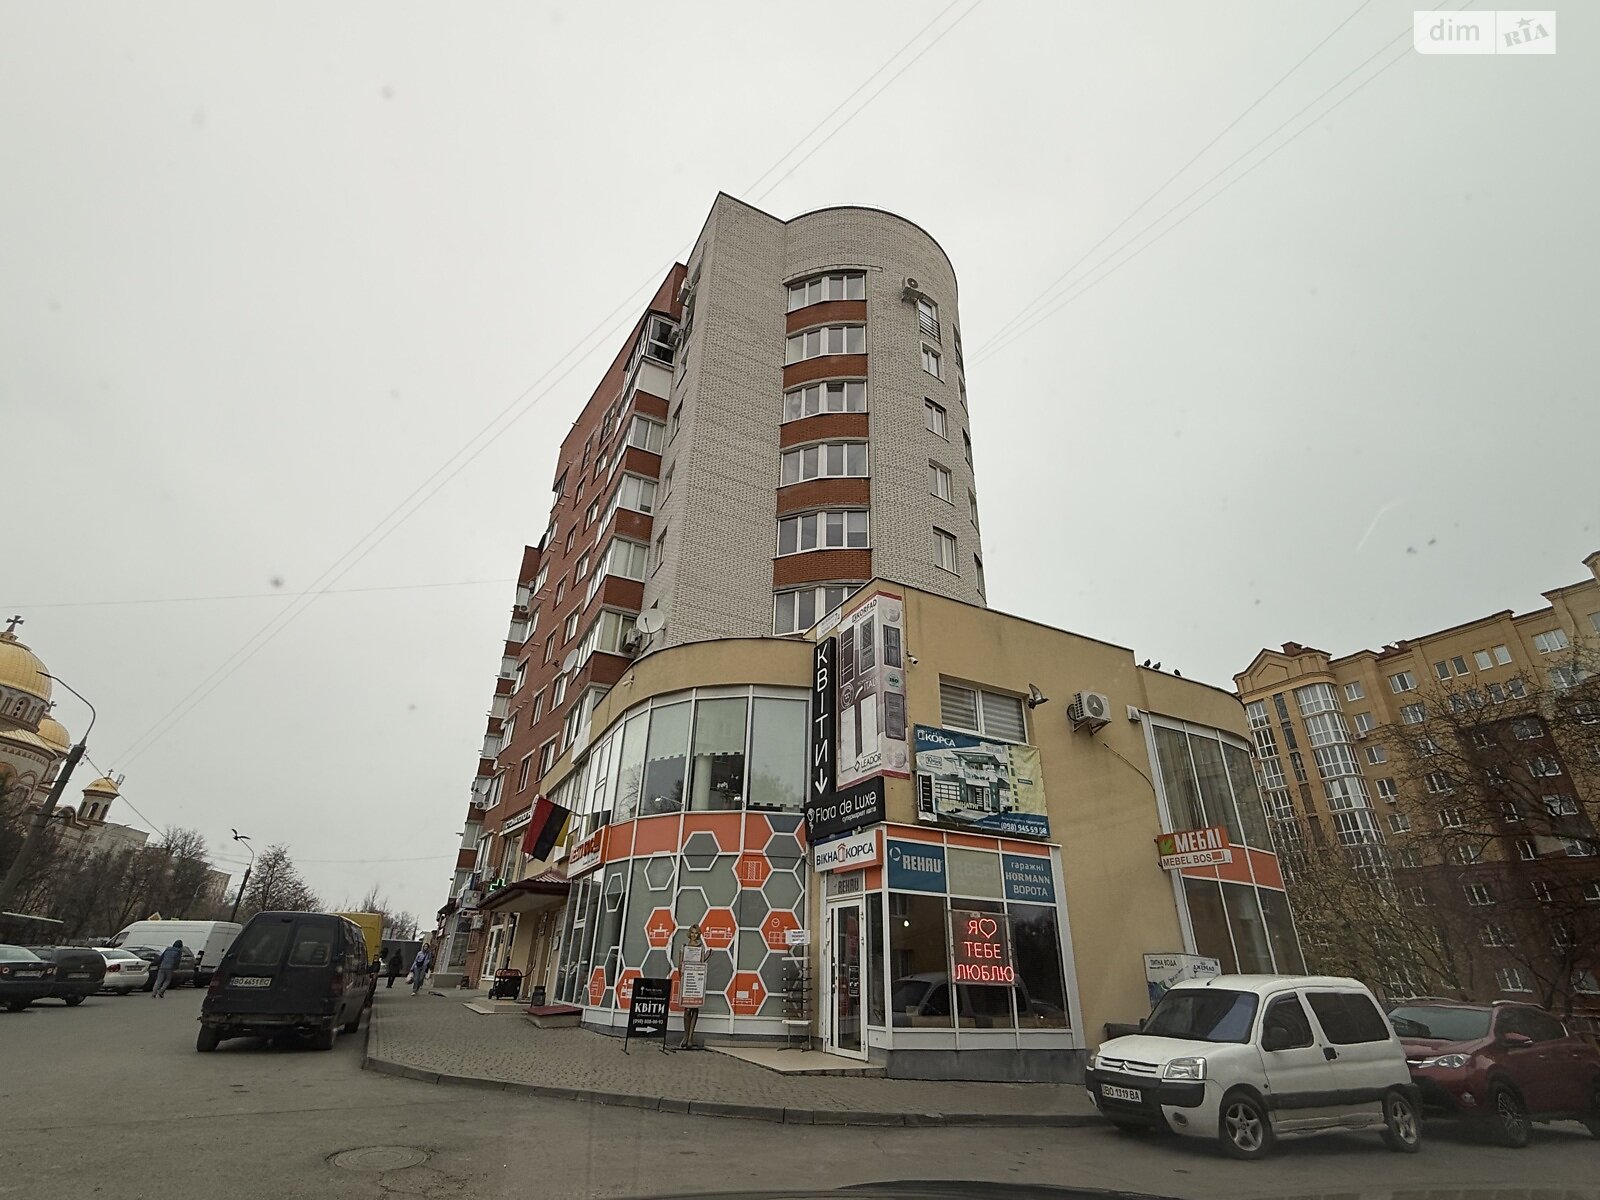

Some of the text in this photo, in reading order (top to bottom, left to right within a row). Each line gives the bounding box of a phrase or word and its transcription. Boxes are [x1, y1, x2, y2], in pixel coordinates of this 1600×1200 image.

[815, 643, 829, 767] КВІТИ
[925, 732, 956, 748] КОРСА
[860, 753, 882, 769] LEADOR
[815, 791, 877, 823] Flora de Luxe
[1173, 827, 1223, 853] МЕБЛІ
[816, 842, 874, 866] ВІКНА КОРСА
[1163, 855, 1192, 868] MEBEL
[902, 855, 942, 873] REHAU
[1011, 861, 1044, 871] гаражні
[838, 877, 859, 893] REHAU
[1013, 884, 1048, 896] ВОРОТА
[968, 920, 979, 935] Я
[964, 941, 1002, 959] ТЕБЕ
[955, 963, 1015, 982] ЛЮБЛЮ
